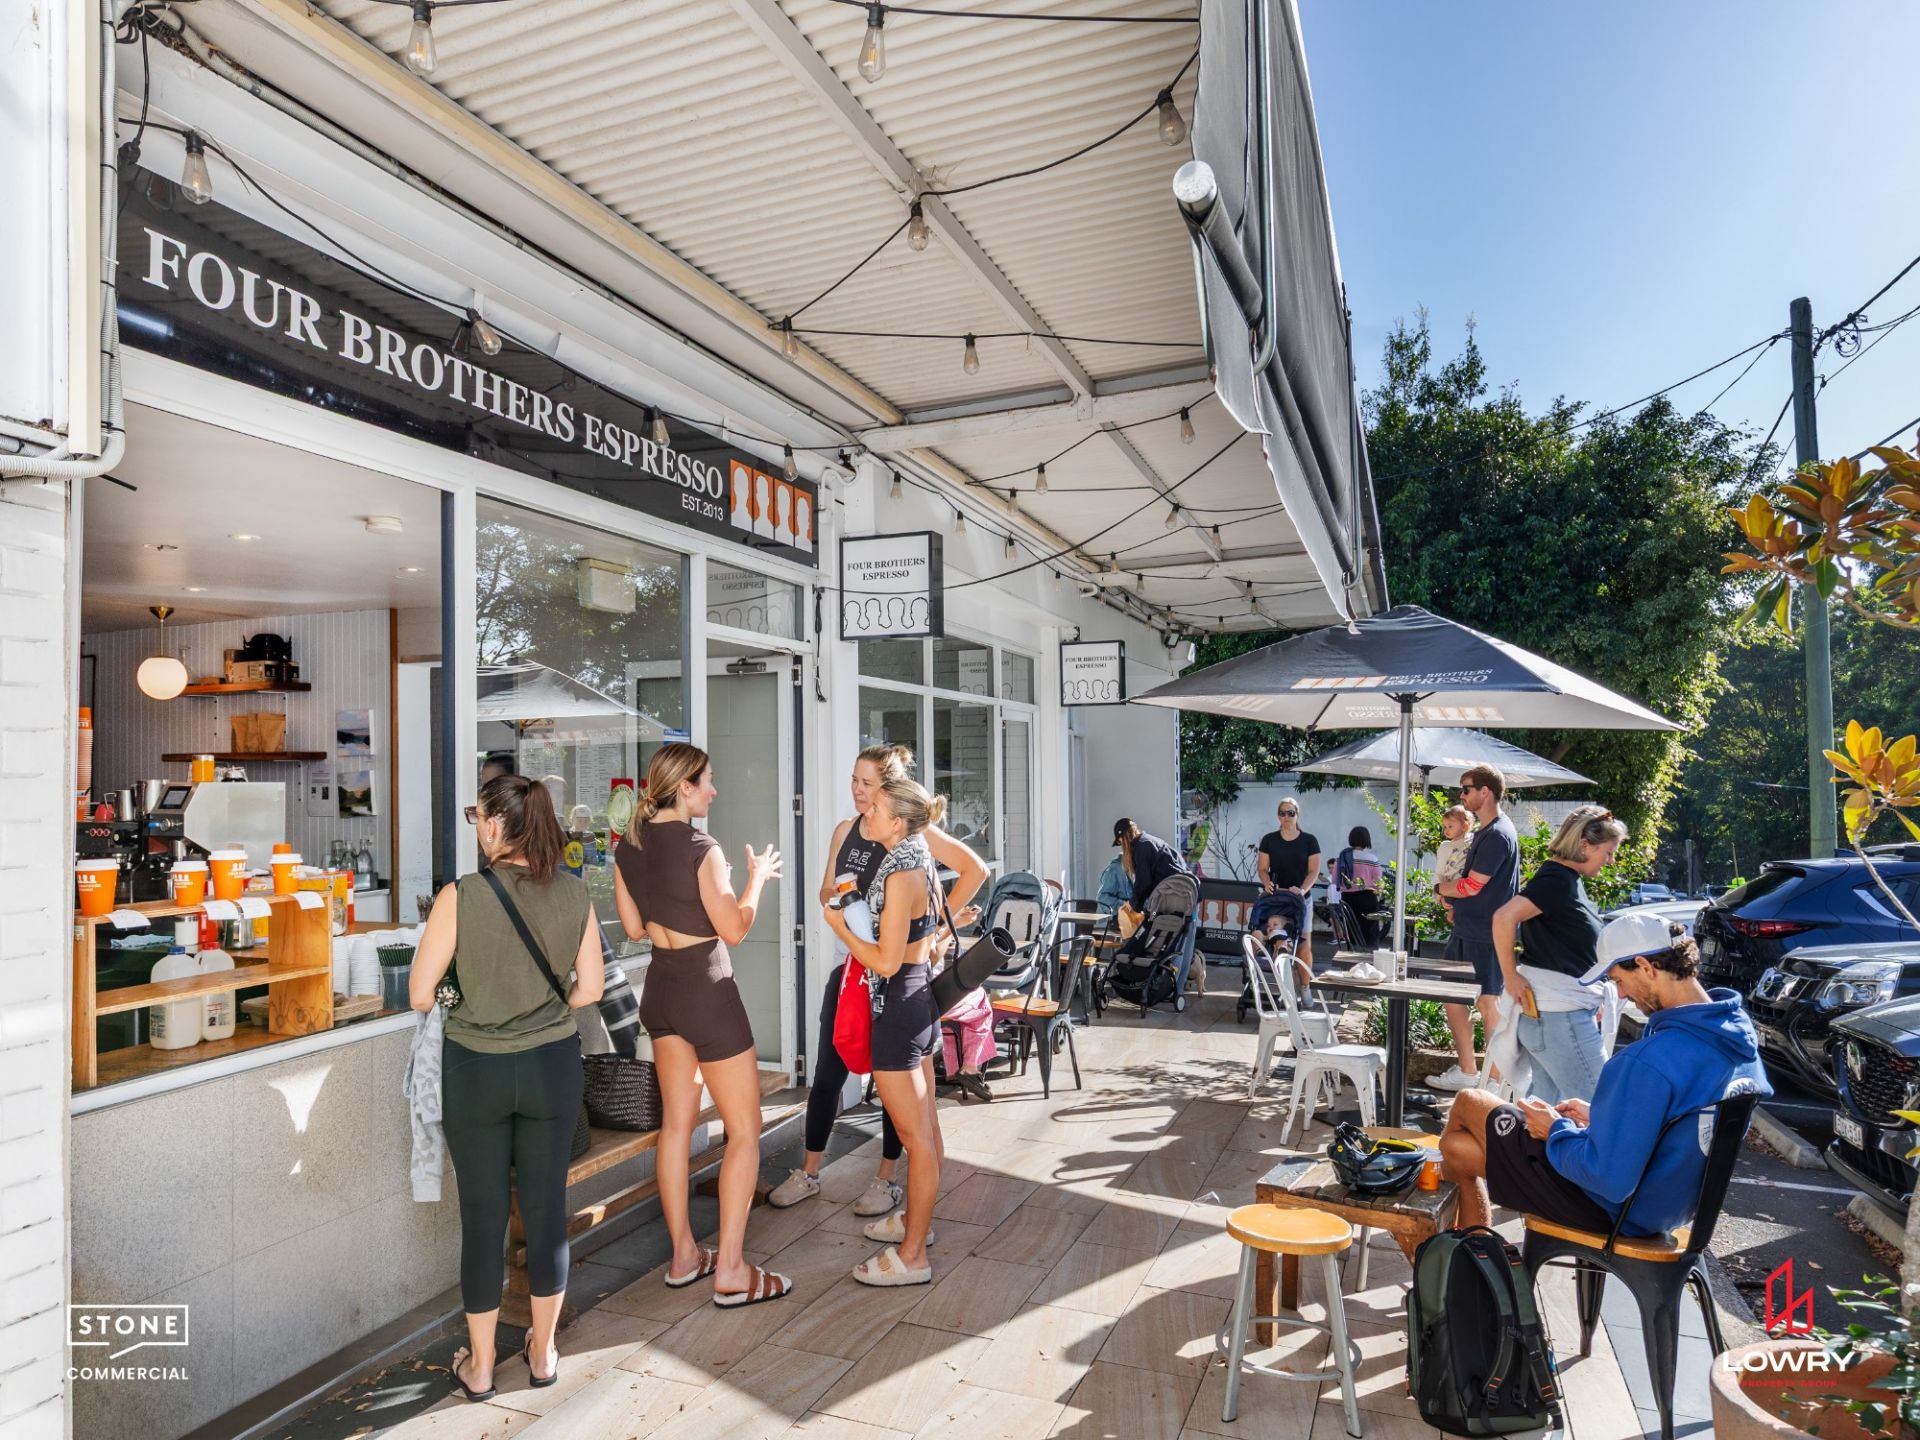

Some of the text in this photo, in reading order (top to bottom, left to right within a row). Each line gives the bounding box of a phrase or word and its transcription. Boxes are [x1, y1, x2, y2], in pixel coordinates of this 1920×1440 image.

[142, 227, 724, 499] FOUR BROTHERS ESPRESSO
[847, 557, 926, 571] FOUR BROTHERS
[862, 569, 910, 581] ESPRESSO
[1426, 669, 1493, 678] BROTHERS
[1384, 675, 1489, 686] ESPRESSO
